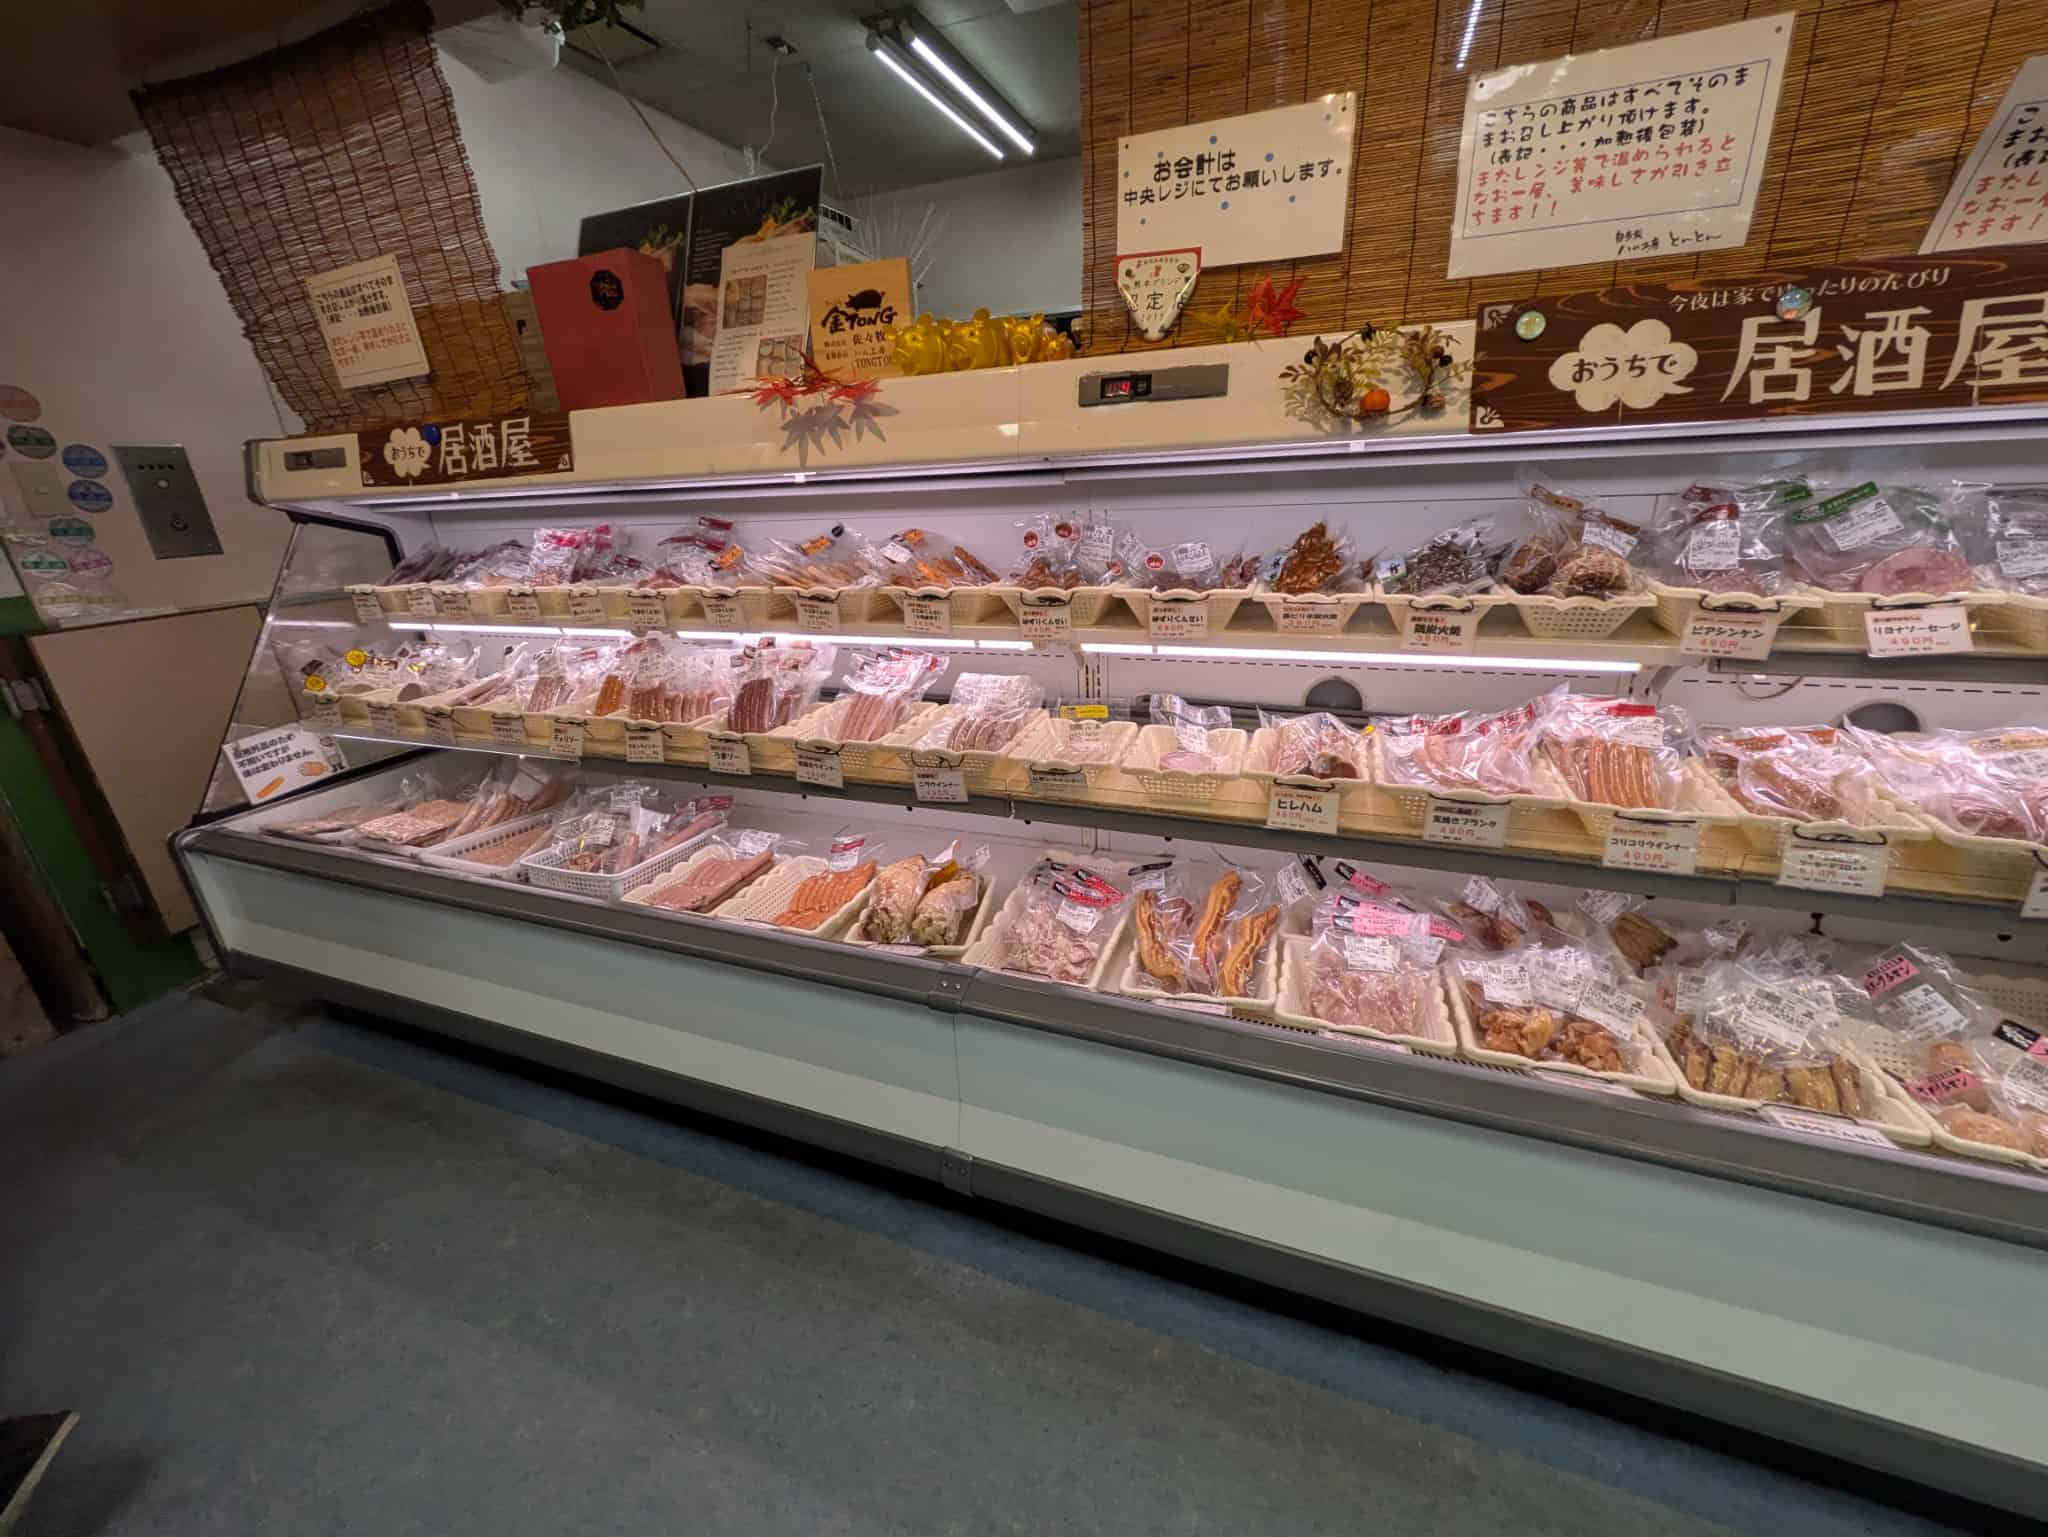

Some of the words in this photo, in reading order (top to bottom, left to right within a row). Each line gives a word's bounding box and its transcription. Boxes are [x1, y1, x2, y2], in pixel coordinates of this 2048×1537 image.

[1486, 67, 1749, 127] こちらの商品はすべてそのま
[1483, 98, 1709, 147] まお召し上がり頂けます。
[1123, 159, 1342, 206] 中央レジにてお願いします。
[1153, 149, 1236, 182] お会計は
[1669, 267, 1949, 313] 今夜は家でたりのんびり
[1571, 351, 1679, 383] おうちで
[1719, 297, 2048, 404] 居酒屋
[391, 446, 425, 461] おうちで
[438, 416, 540, 475] 居酒屋
[1277, 799, 1323, 813] ヒレハム
[1611, 838, 1689, 851] コリコリウインナー
